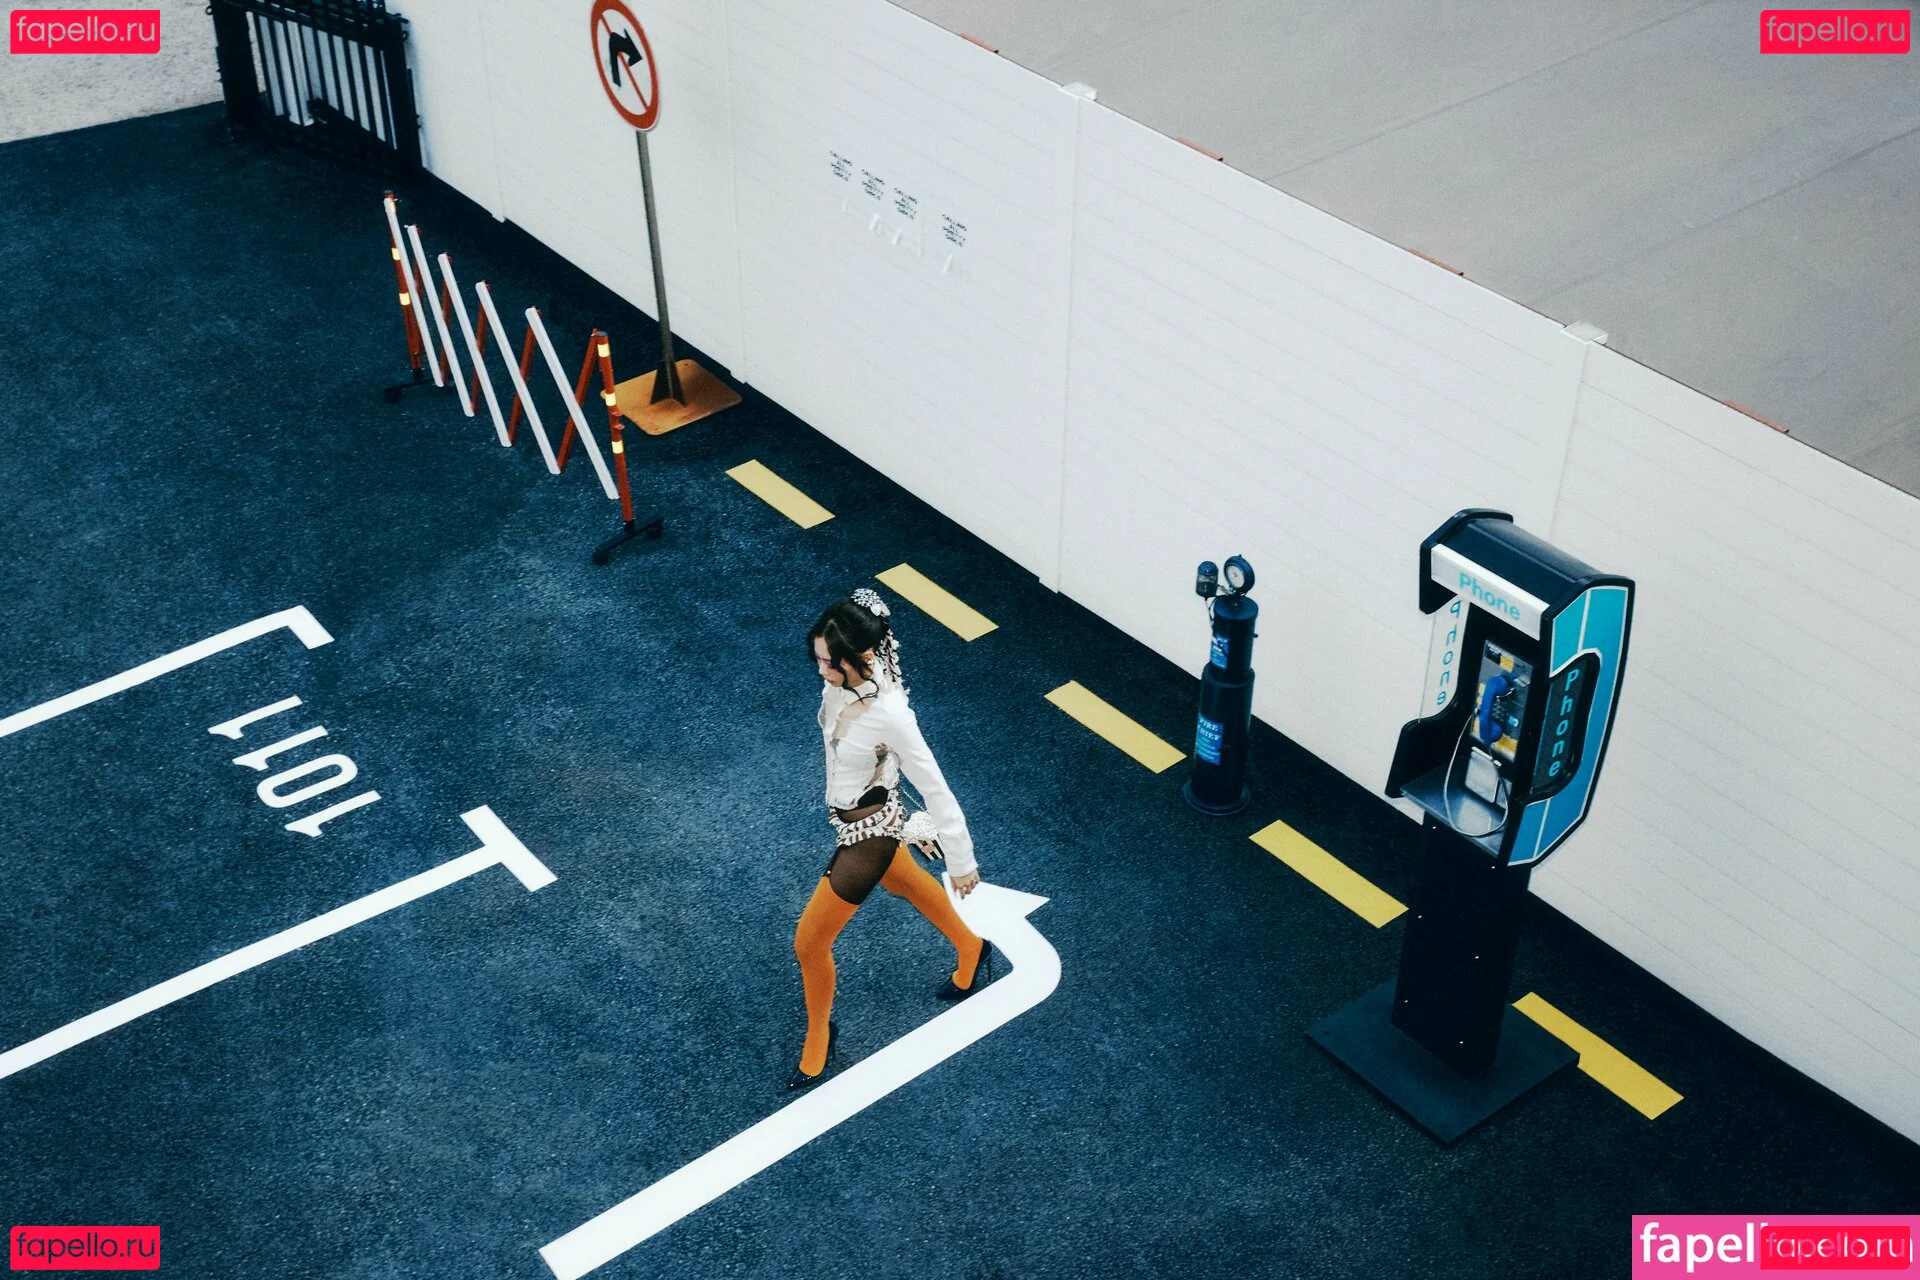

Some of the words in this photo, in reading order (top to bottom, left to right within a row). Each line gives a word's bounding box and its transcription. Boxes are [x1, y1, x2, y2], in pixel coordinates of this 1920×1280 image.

[1458, 572, 1520, 621] Phone
[207, 695, 382, 838] 1011
[1548, 668, 1580, 777] Phone
